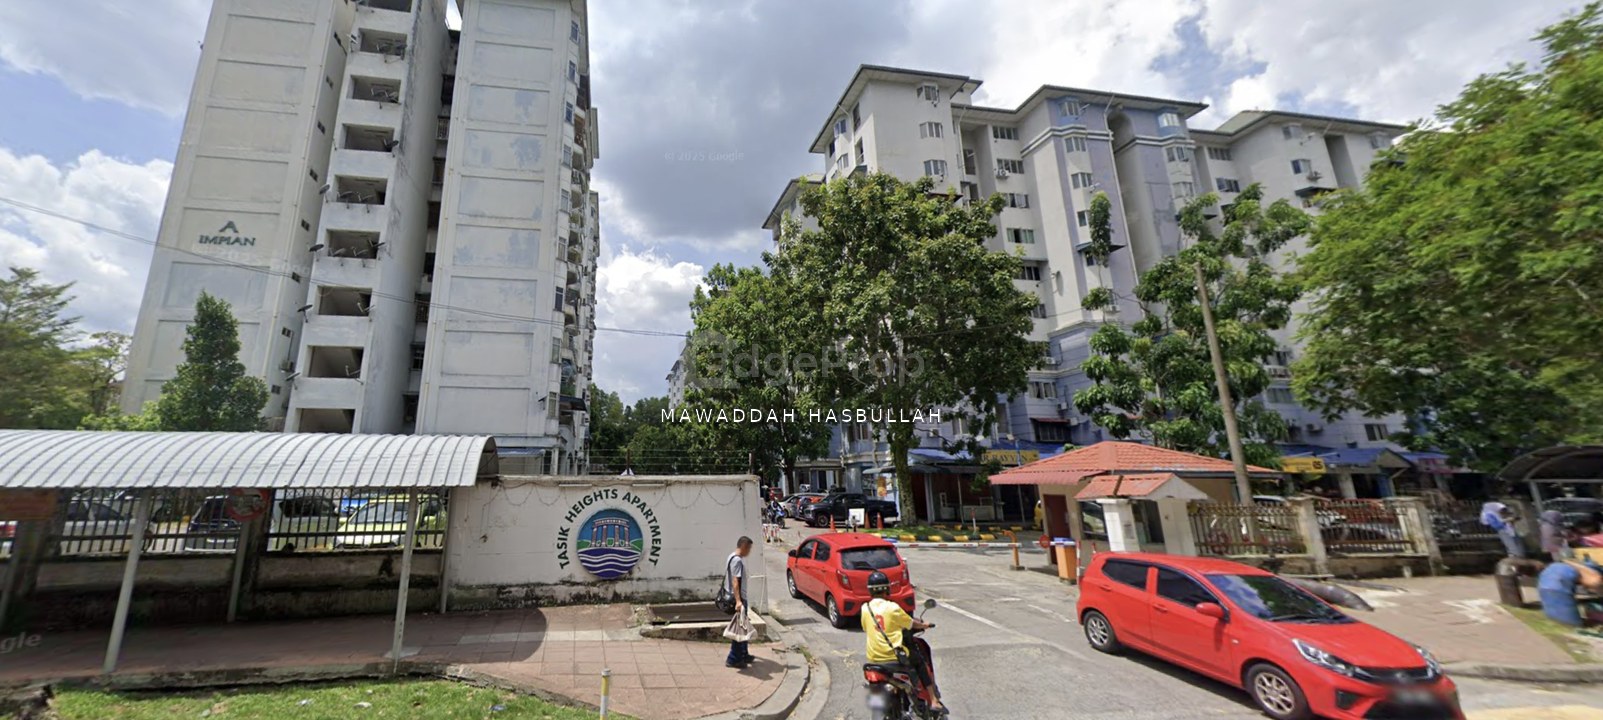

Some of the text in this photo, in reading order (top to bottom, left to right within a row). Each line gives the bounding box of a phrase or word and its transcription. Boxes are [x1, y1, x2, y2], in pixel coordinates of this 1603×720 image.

[198, 235, 256, 246] IMPIAN
[556, 488, 662, 570] TASIK HEIGHTS APARTMENT
